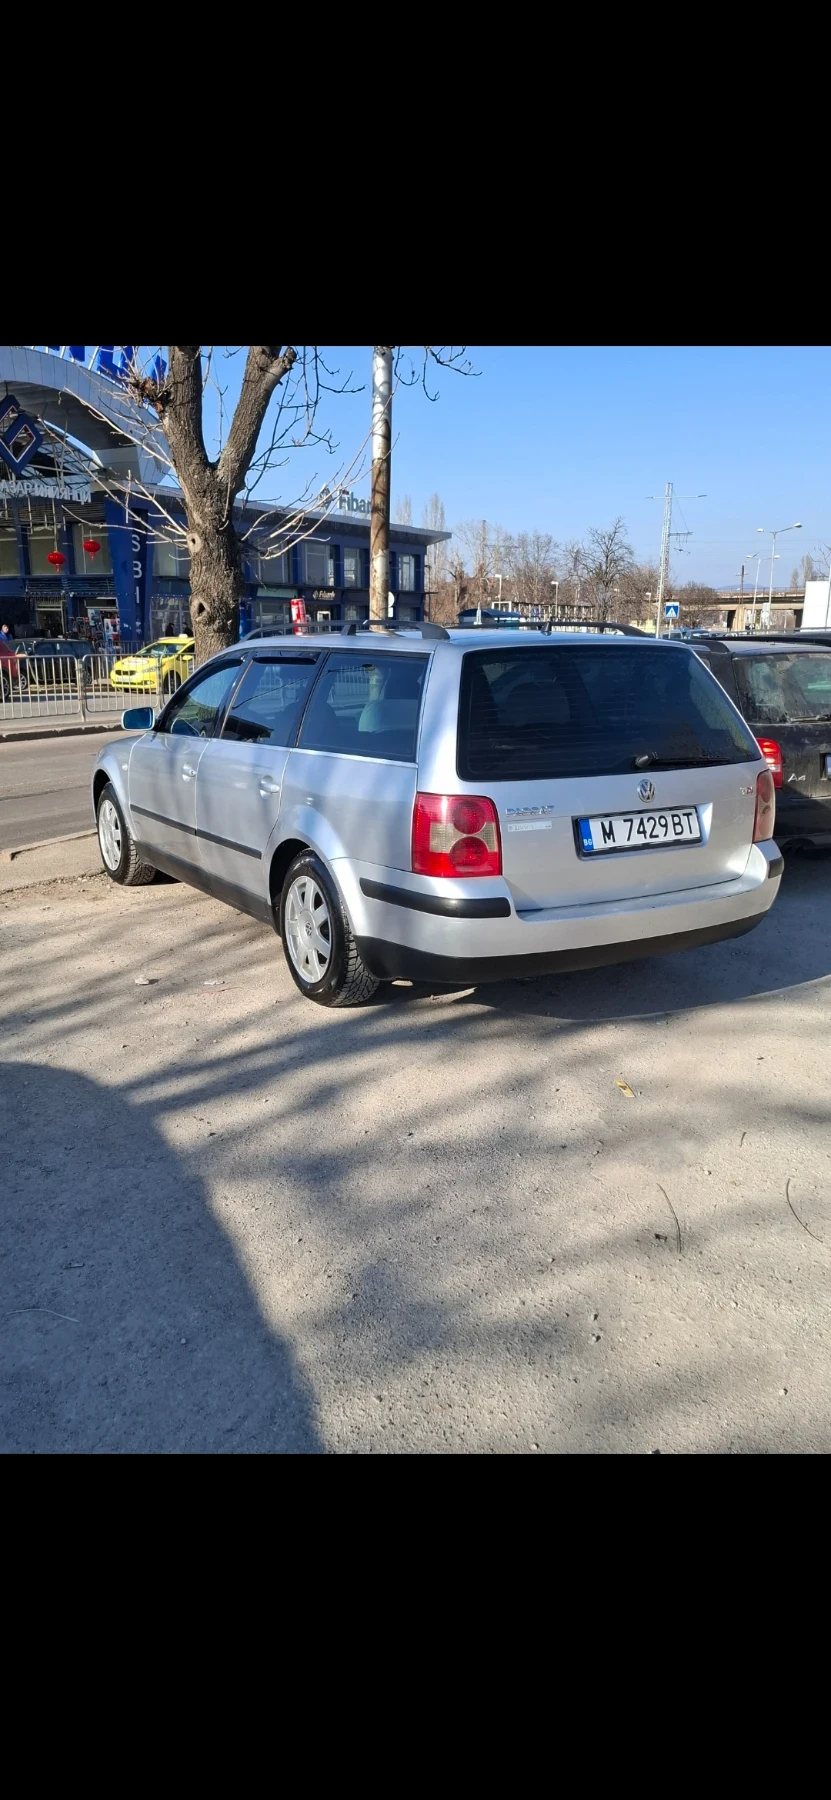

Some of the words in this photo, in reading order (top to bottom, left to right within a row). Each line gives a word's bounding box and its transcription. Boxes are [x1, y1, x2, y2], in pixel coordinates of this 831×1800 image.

[787, 773, 806, 782] A4
[600, 820, 616, 844] M
[623, 812, 693, 842] 7429BT
[583, 838, 593, 846] BG
